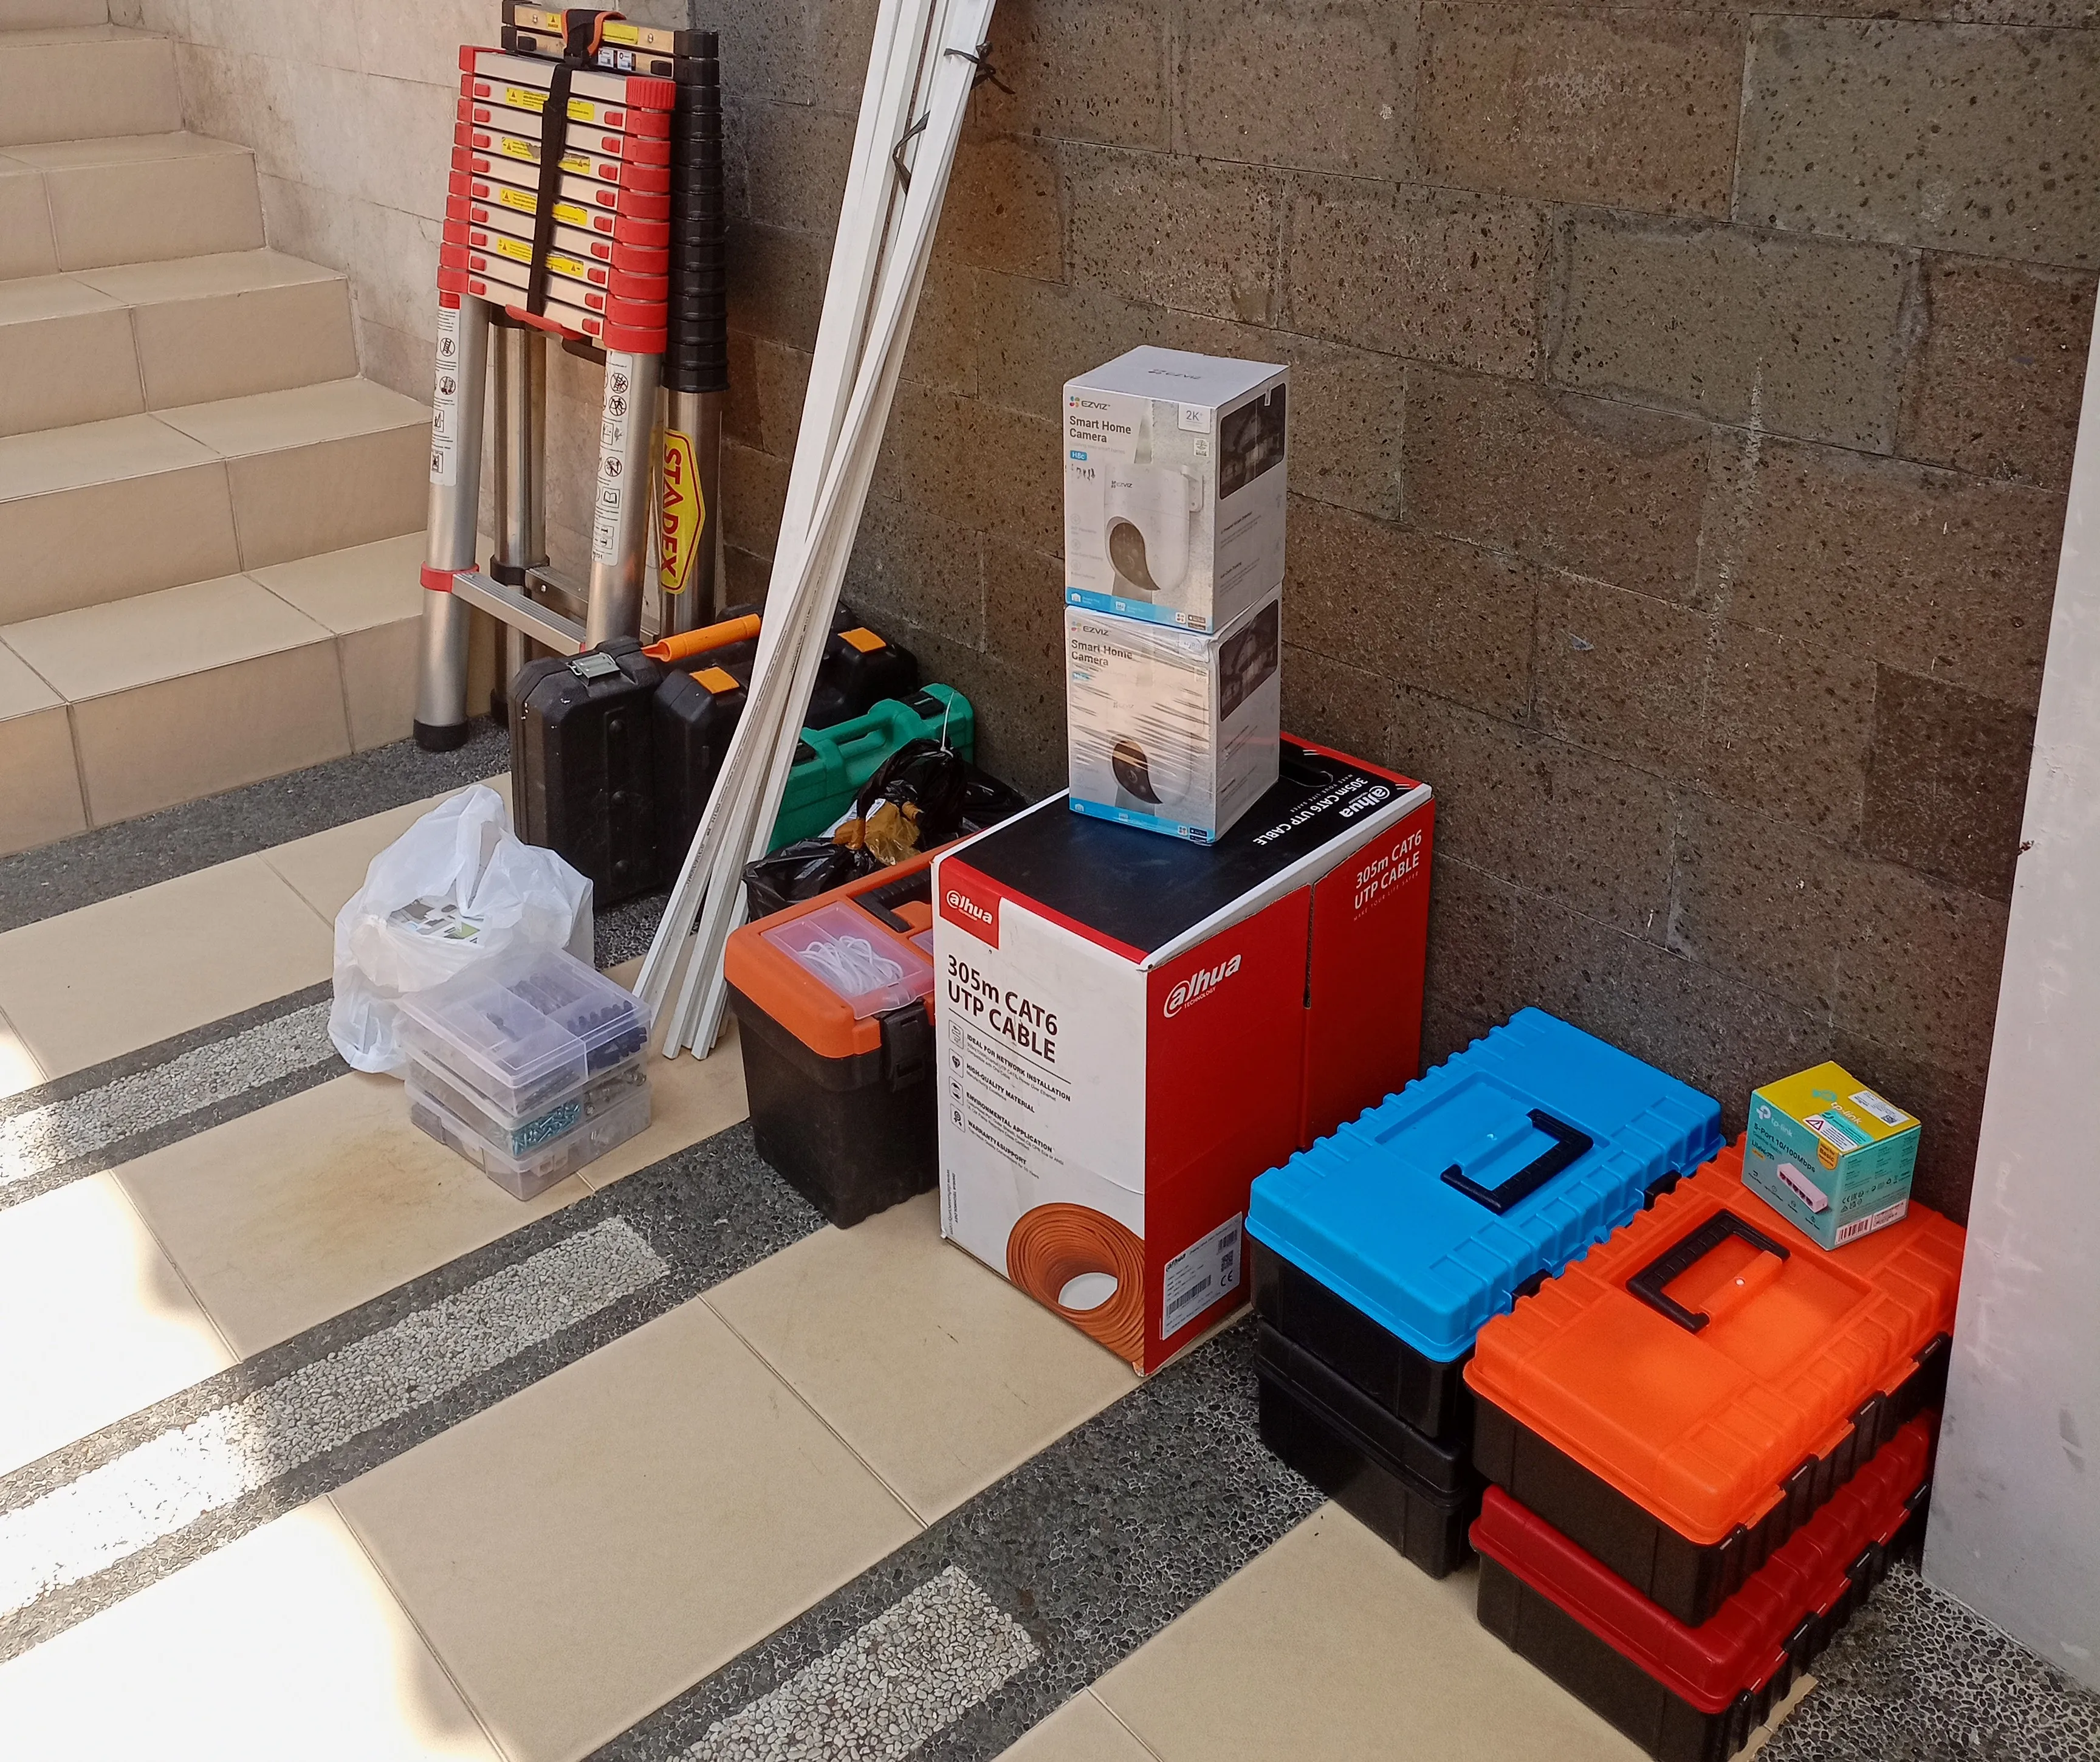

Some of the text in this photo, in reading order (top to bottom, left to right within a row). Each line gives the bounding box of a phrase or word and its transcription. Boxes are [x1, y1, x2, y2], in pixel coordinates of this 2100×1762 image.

[1069, 416, 1131, 435] Smart Home
[1081, 400, 1108, 410] EZVIZ
[1069, 428, 1107, 443] Camera
[661, 443, 684, 579] STADEX
[1083, 625, 1109, 636] EZVIZ
[1103, 645, 1133, 659] Home
[1071, 651, 1109, 666] Camera
[1252, 777, 1368, 846] 305m CAT6 UTP CABLE
[1355, 851, 1420, 909] UTP CABLE
[1356, 829, 1422, 889] 305m CAT6
[1354, 871, 1419, 921] MAKE YOUR LIFE SAFER
[948, 954, 1058, 1036] 305m CAT6
[1184, 986, 1216, 1009] TECHNOLOGY
[948, 979, 984, 1017] UTP
[989, 1008, 1055, 1064] CABLE
[966, 1070, 1007, 1101] Manufacturing Excellence
[966, 1063, 1035, 1113] HIGH-QUALITY MATERIAL
[967, 1034, 983, 1049] IDEAL
[984, 1044, 996, 1058] FOR
[996, 1053, 1026, 1076] NETWORK
[1026, 1072, 1071, 1102] INSTALLATION
[966, 1092, 1052, 1153] ENVIRONMENTAL APPLICATION
[967, 1120, 1027, 1165] WARRANTY&SUPPORT
[1771, 1117, 1793, 1138] tp-link
[1753, 1122, 1775, 1143] 5-Port
[1776, 1138, 1816, 1174] 10/100Mbps
[1819, 1147, 1834, 1162] Basic
